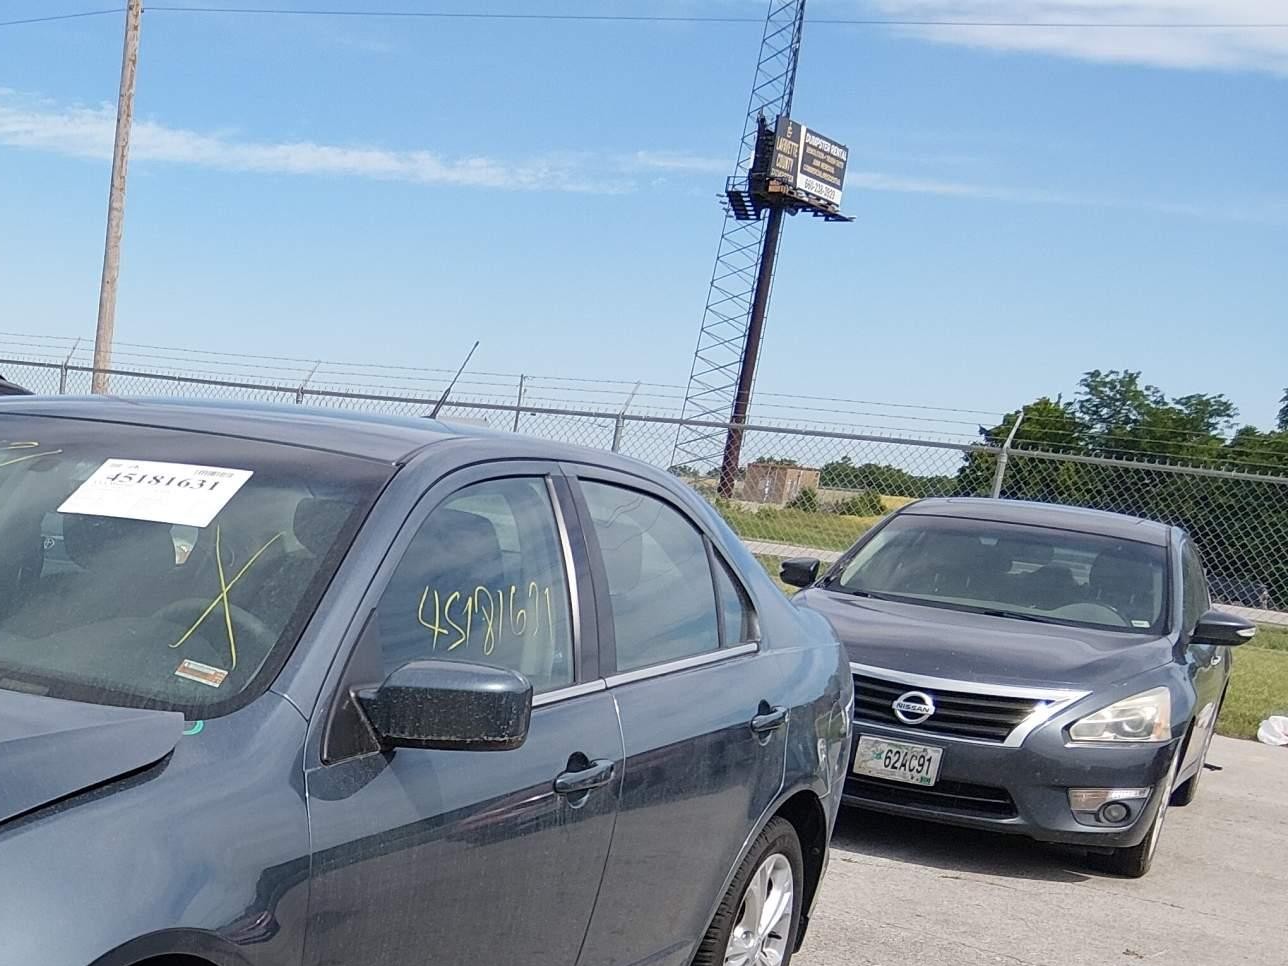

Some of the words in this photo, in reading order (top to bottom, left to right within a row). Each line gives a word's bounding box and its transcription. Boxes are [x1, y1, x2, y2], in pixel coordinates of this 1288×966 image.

[106, 472, 220, 491] 45181631
[896, 702, 930, 713] NISSAN
[883, 749, 932, 776] 62AC91
